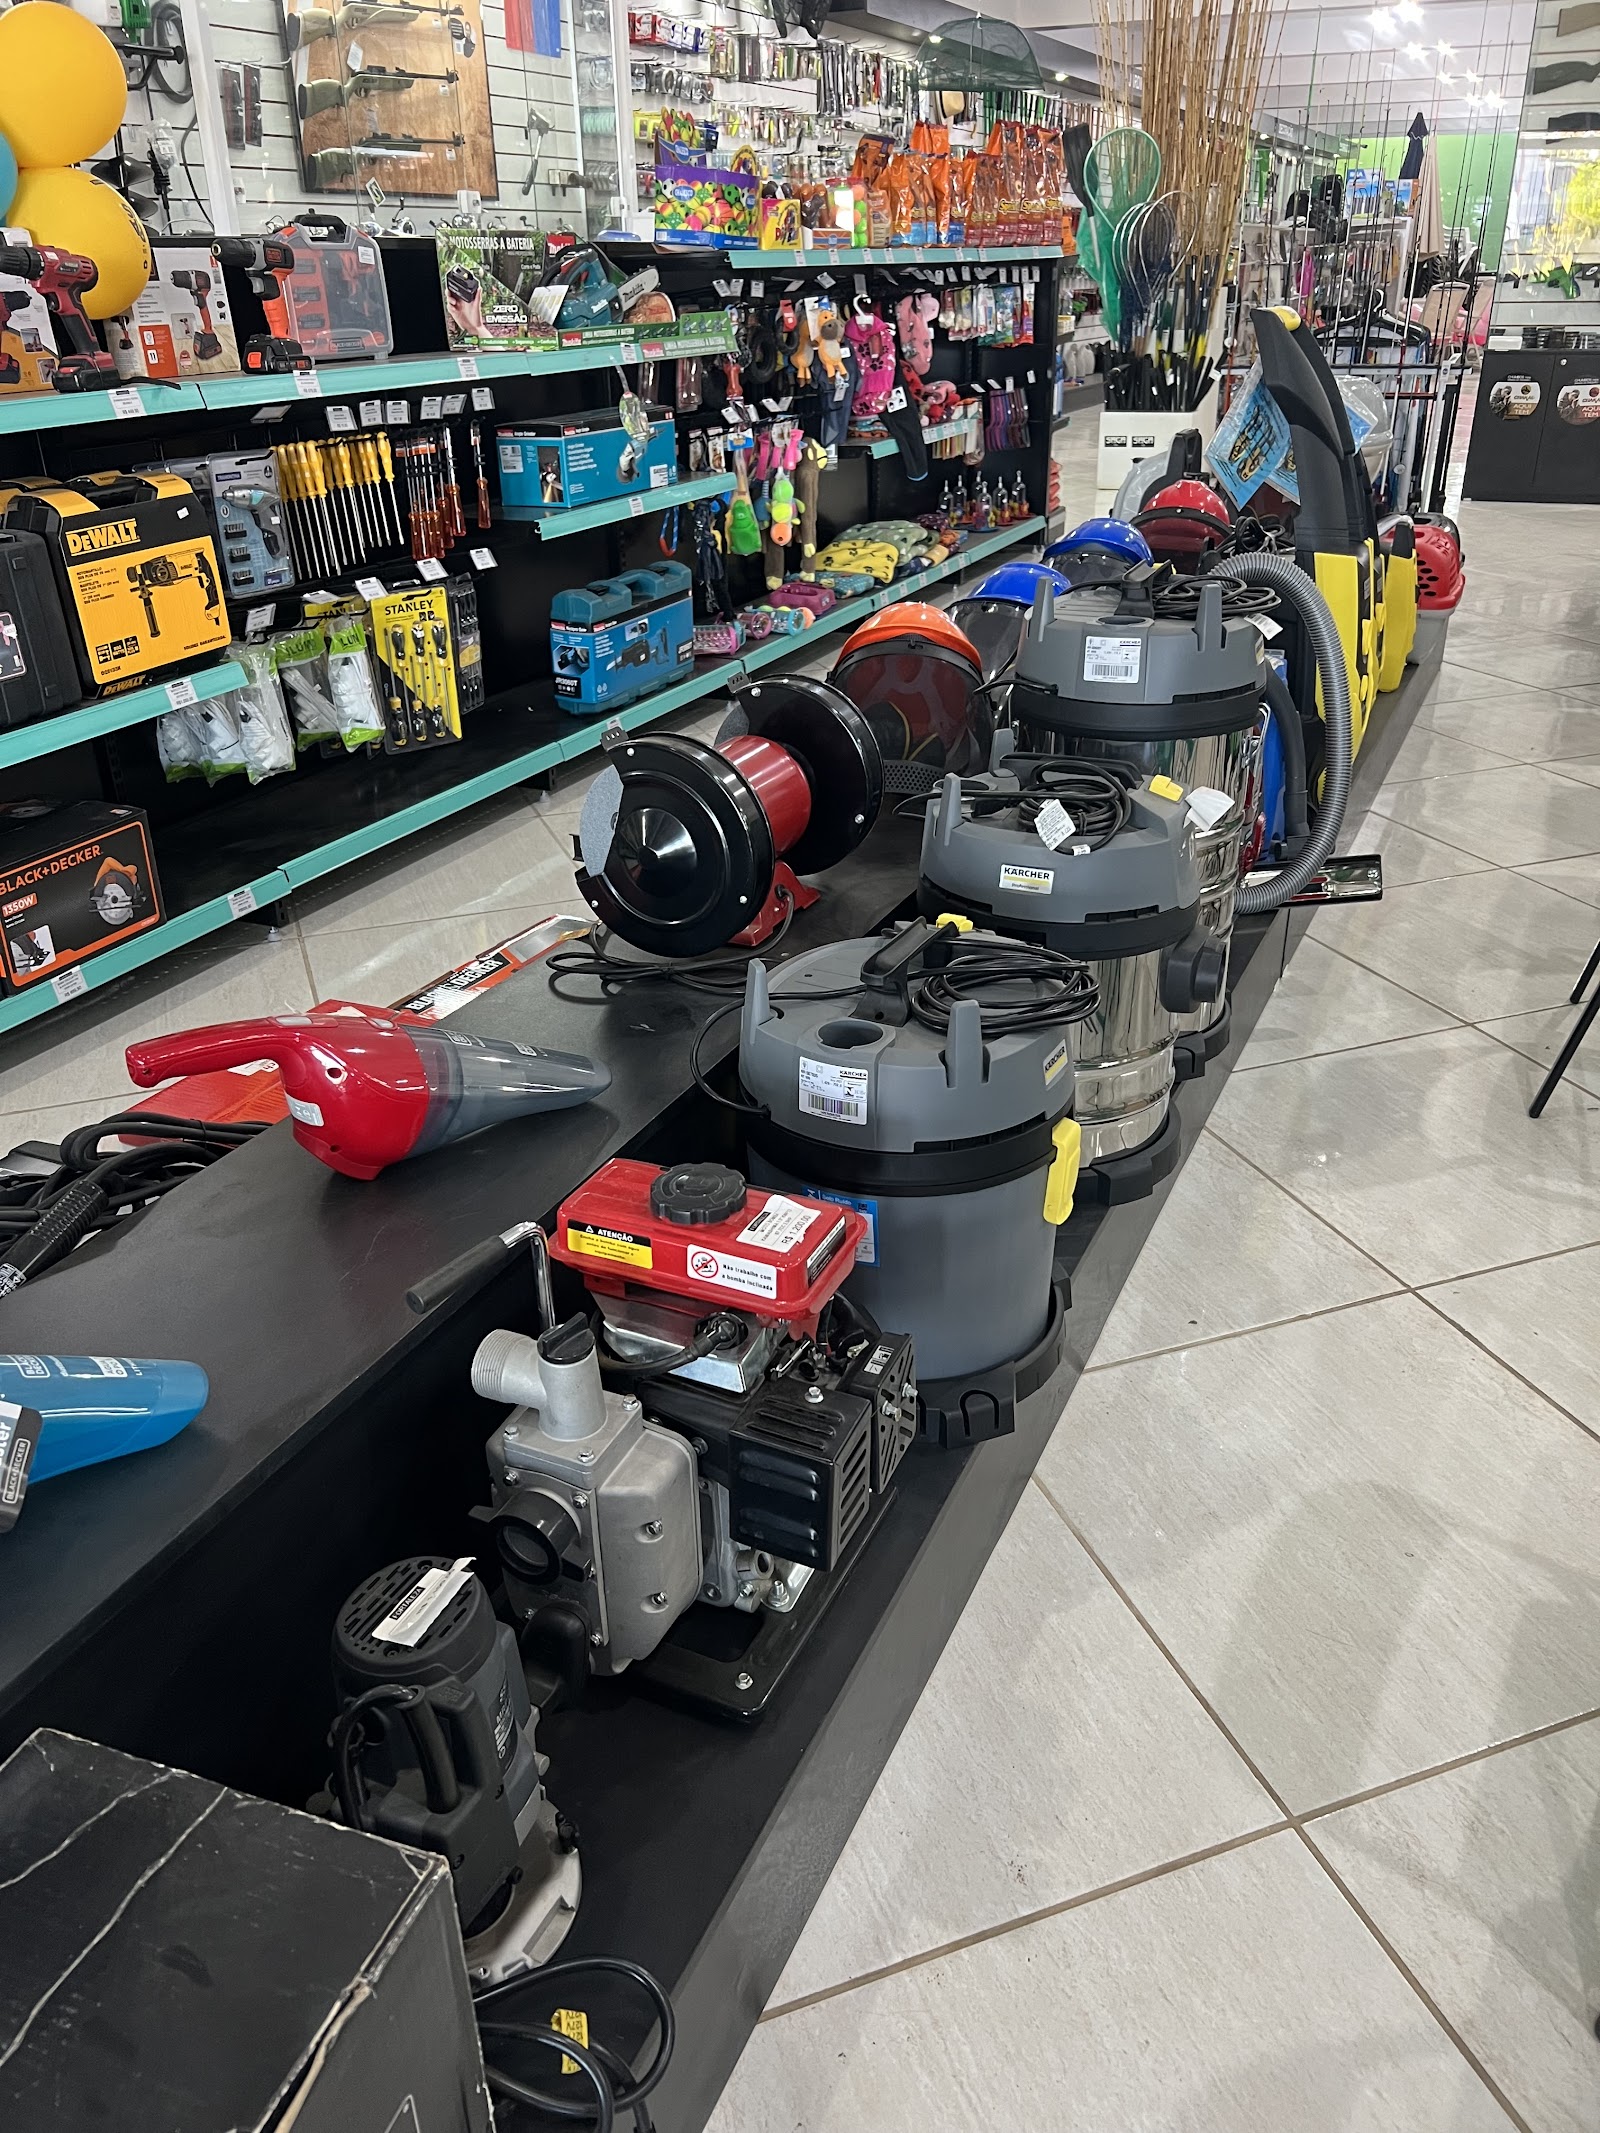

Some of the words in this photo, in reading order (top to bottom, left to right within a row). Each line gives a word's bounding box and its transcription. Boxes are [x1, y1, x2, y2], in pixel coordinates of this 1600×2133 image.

[506, 237, 534, 250] BATERIA
[493, 305, 518, 313] ZERO
[486, 314, 527, 323] EMISSÃO
[384, 599, 434, 616] STANLEY
[3, 896, 34, 915] 1350W
[597, 1228, 634, 1243] ATENÇÃO
[781, 1235, 793, 1244] R$
[722, 1263, 734, 1271] Não
[735, 1267, 759, 1278] trabalhe
[727, 1274, 746, 1284] bomba
[747, 1279, 773, 1291] inclinada
[6, 1441, 27, 1501] BLACK+DECKER
[391, 1587, 423, 1619] FORTALEZA
